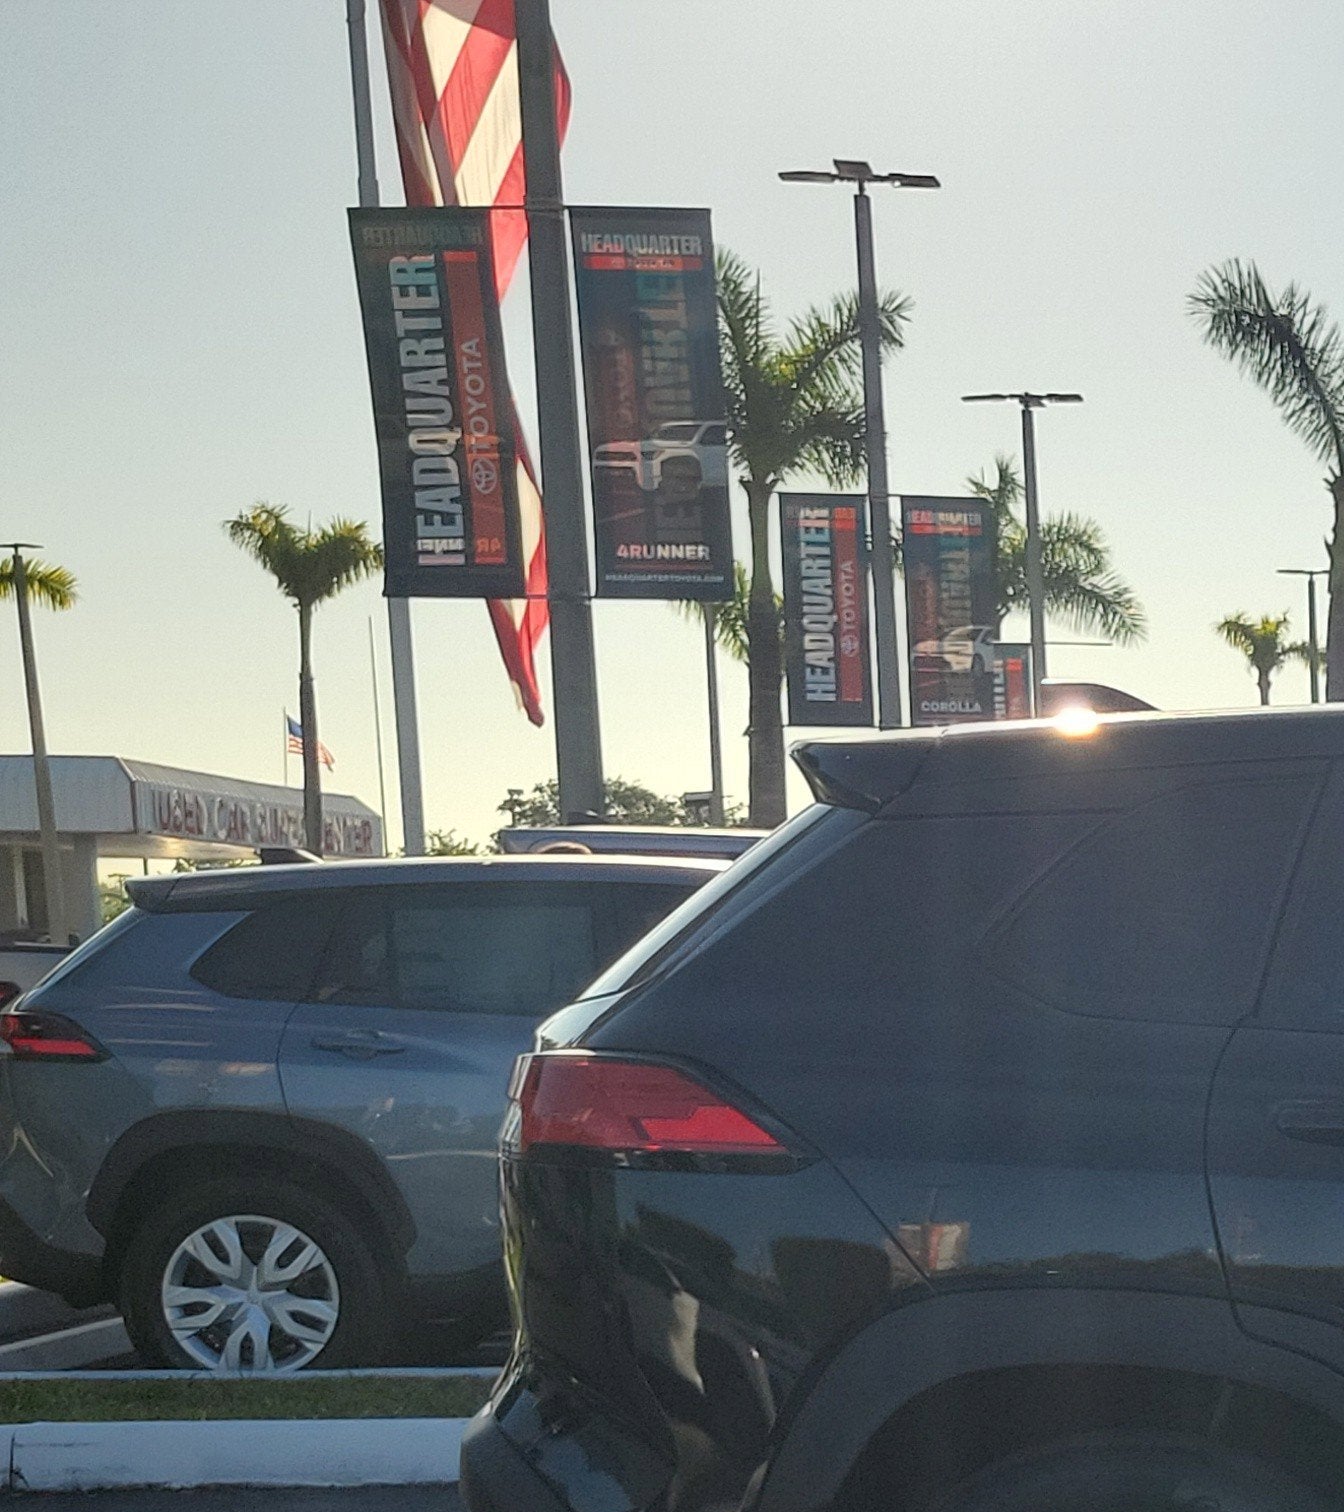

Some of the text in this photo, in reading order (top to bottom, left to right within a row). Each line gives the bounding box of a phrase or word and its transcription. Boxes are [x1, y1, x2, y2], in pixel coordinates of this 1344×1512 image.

[583, 234, 702, 257] HEADQUARTER
[389, 254, 465, 566] HEADQUARTER
[460, 338, 491, 454] TOYOTA
[616, 544, 711, 560] 4RUNNER
[799, 507, 838, 701] HEADQUARTER
[841, 561, 857, 629] TOYOTA
[920, 701, 981, 713] COROLLA
[156, 790, 208, 835] USED
[214, 797, 252, 842] CAR
[322, 814, 374, 854] ENTER
